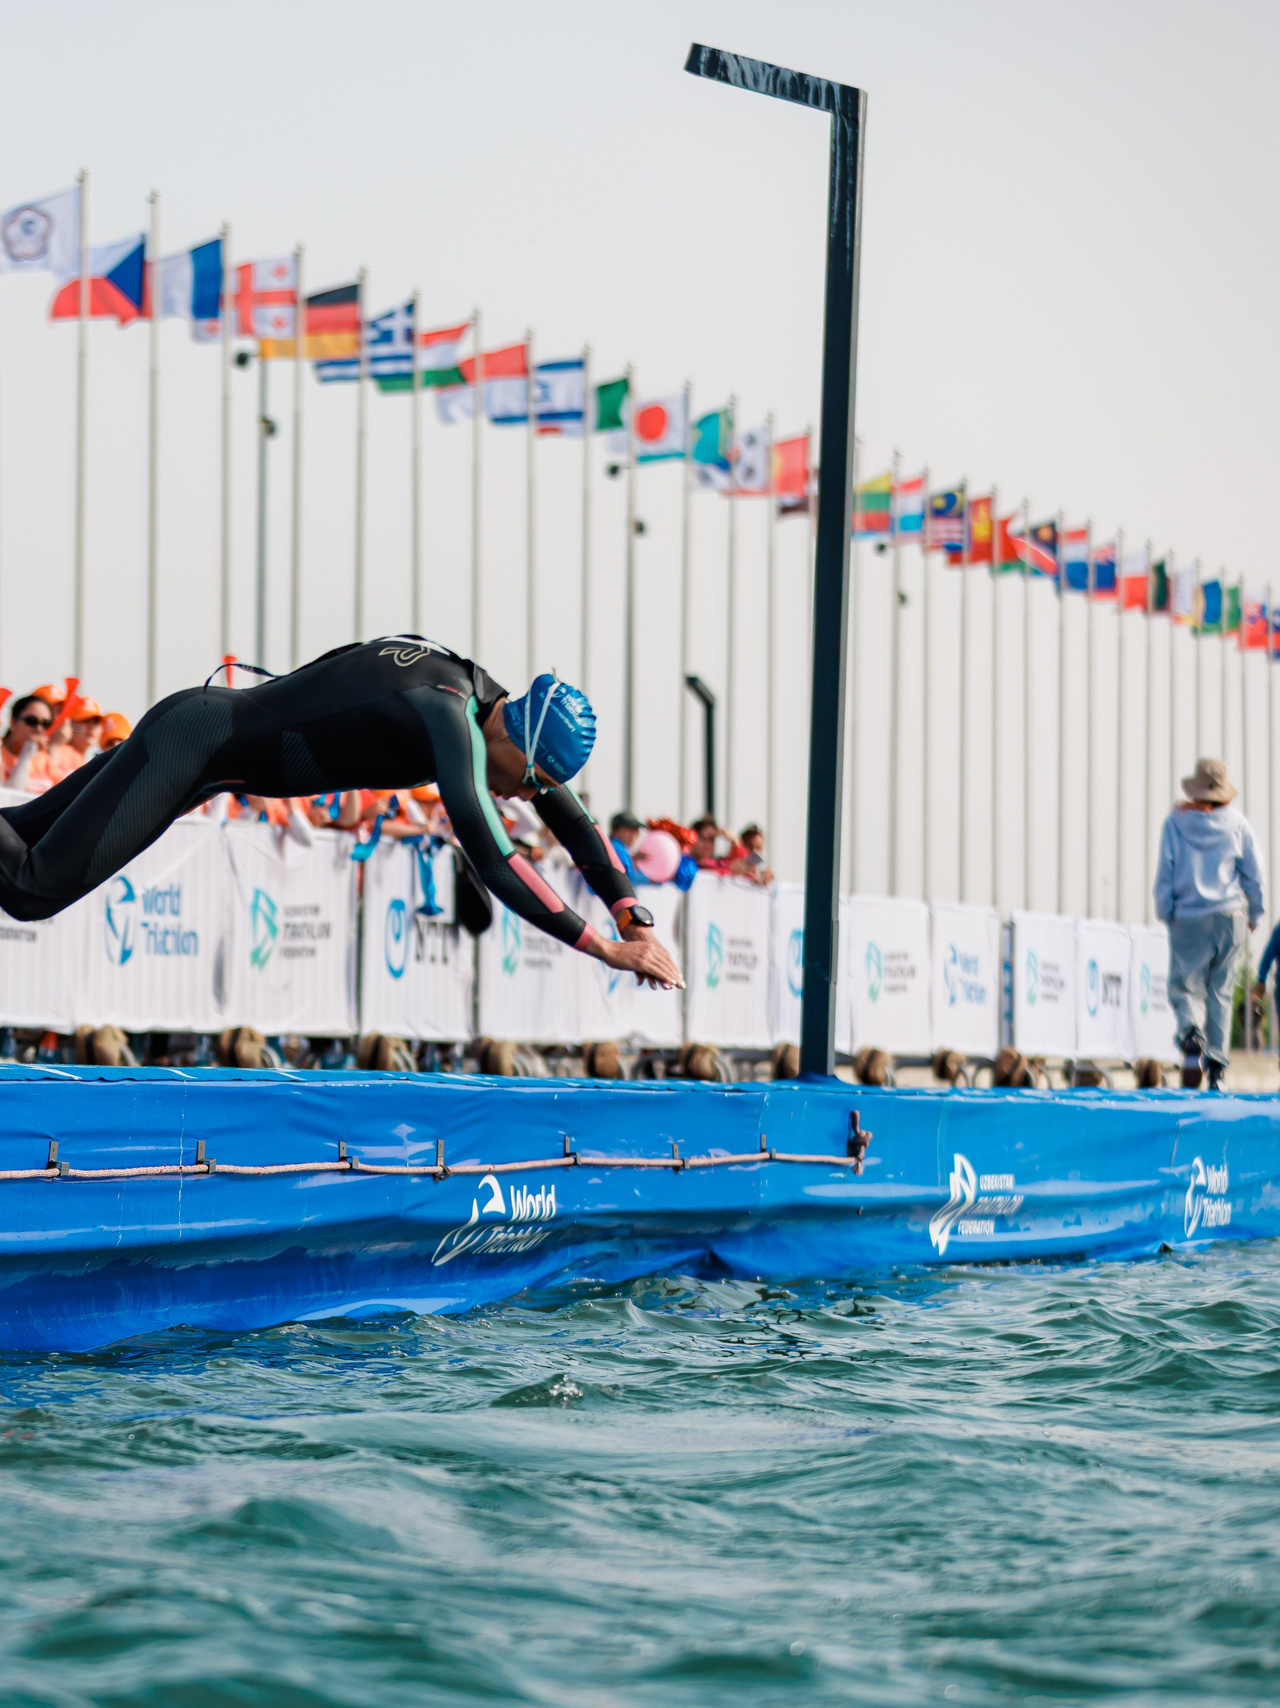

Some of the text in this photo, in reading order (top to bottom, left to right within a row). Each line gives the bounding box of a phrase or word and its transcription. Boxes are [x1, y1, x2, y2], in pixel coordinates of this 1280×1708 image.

[142, 882, 182, 917] World
[979, 1173, 1015, 1191] UZBEKISTAN
[1205, 1164, 1229, 1195] World
[508, 1184, 556, 1223] World
[957, 1219, 995, 1236] FEDERATION
